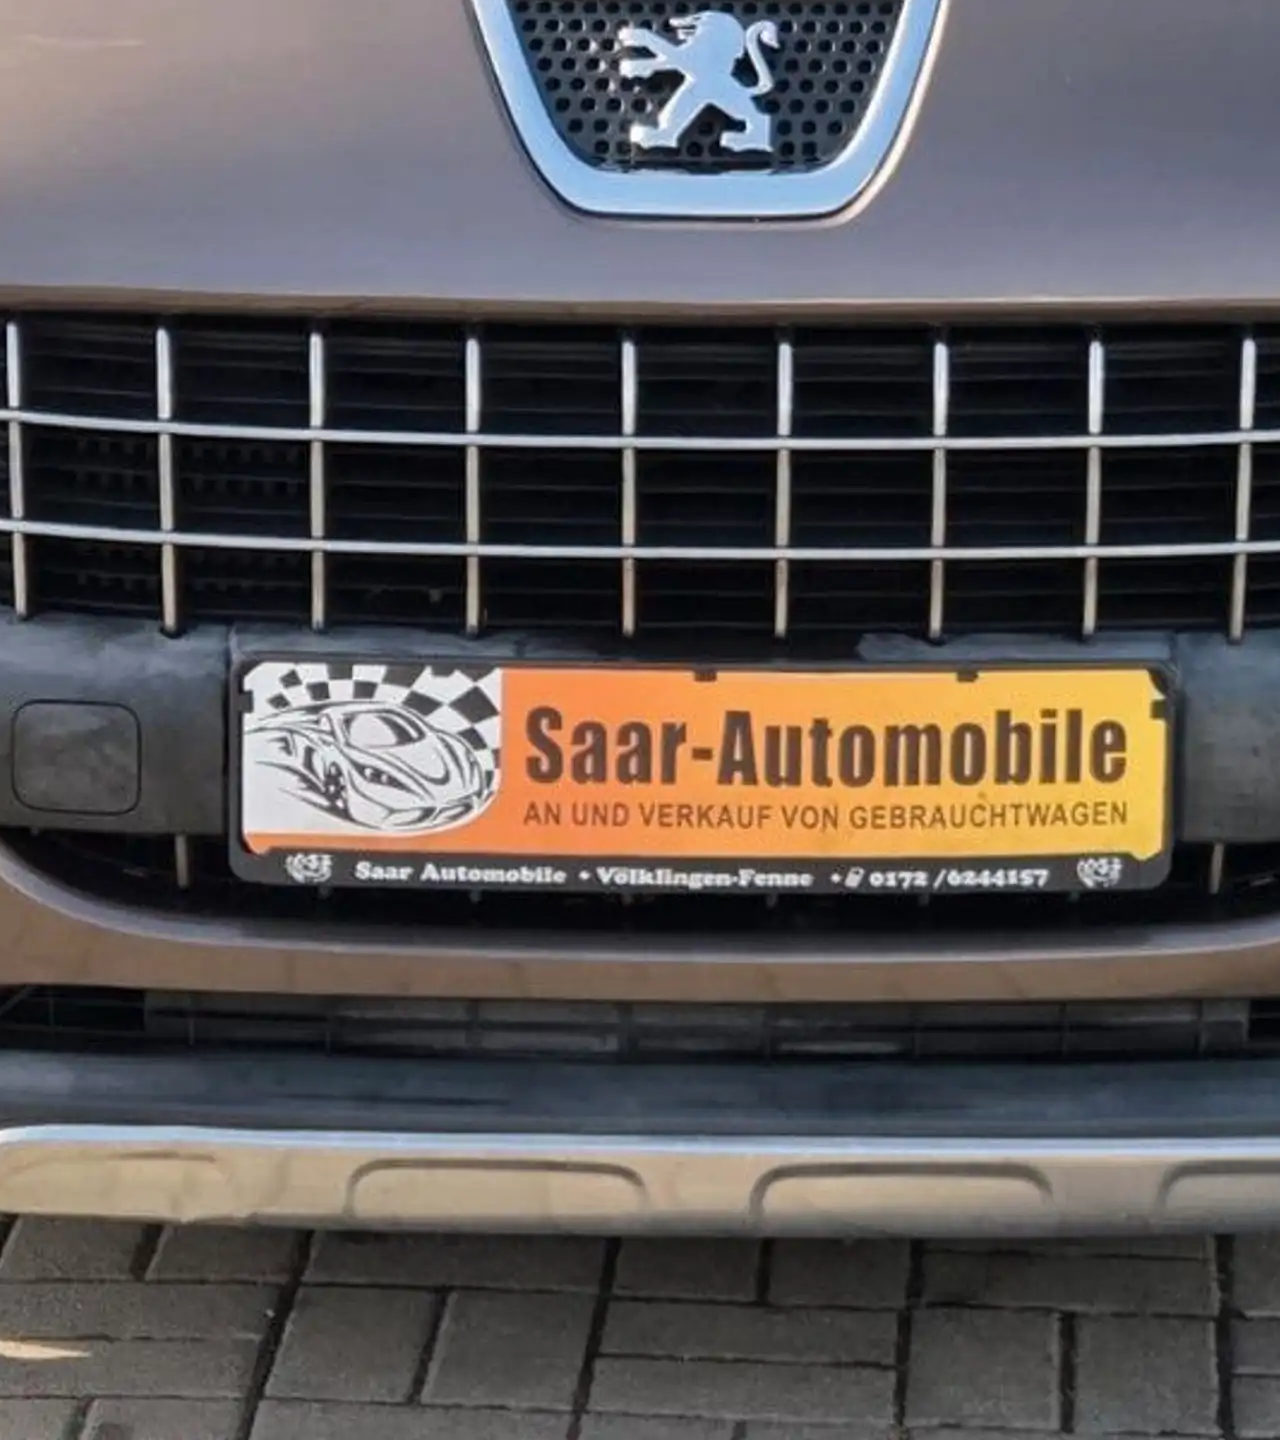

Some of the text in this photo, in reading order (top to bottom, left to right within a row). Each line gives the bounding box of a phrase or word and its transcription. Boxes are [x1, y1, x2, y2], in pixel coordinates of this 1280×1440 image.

[525, 706, 1127, 788] Saar-Automobile
[523, 801, 1128, 830] AN UND VERKAUF VON GEBRAUCHTWAGEN
[355, 861, 413, 880] Saar
[420, 863, 567, 883] Automobile
[869, 869, 928, 889] 0172
